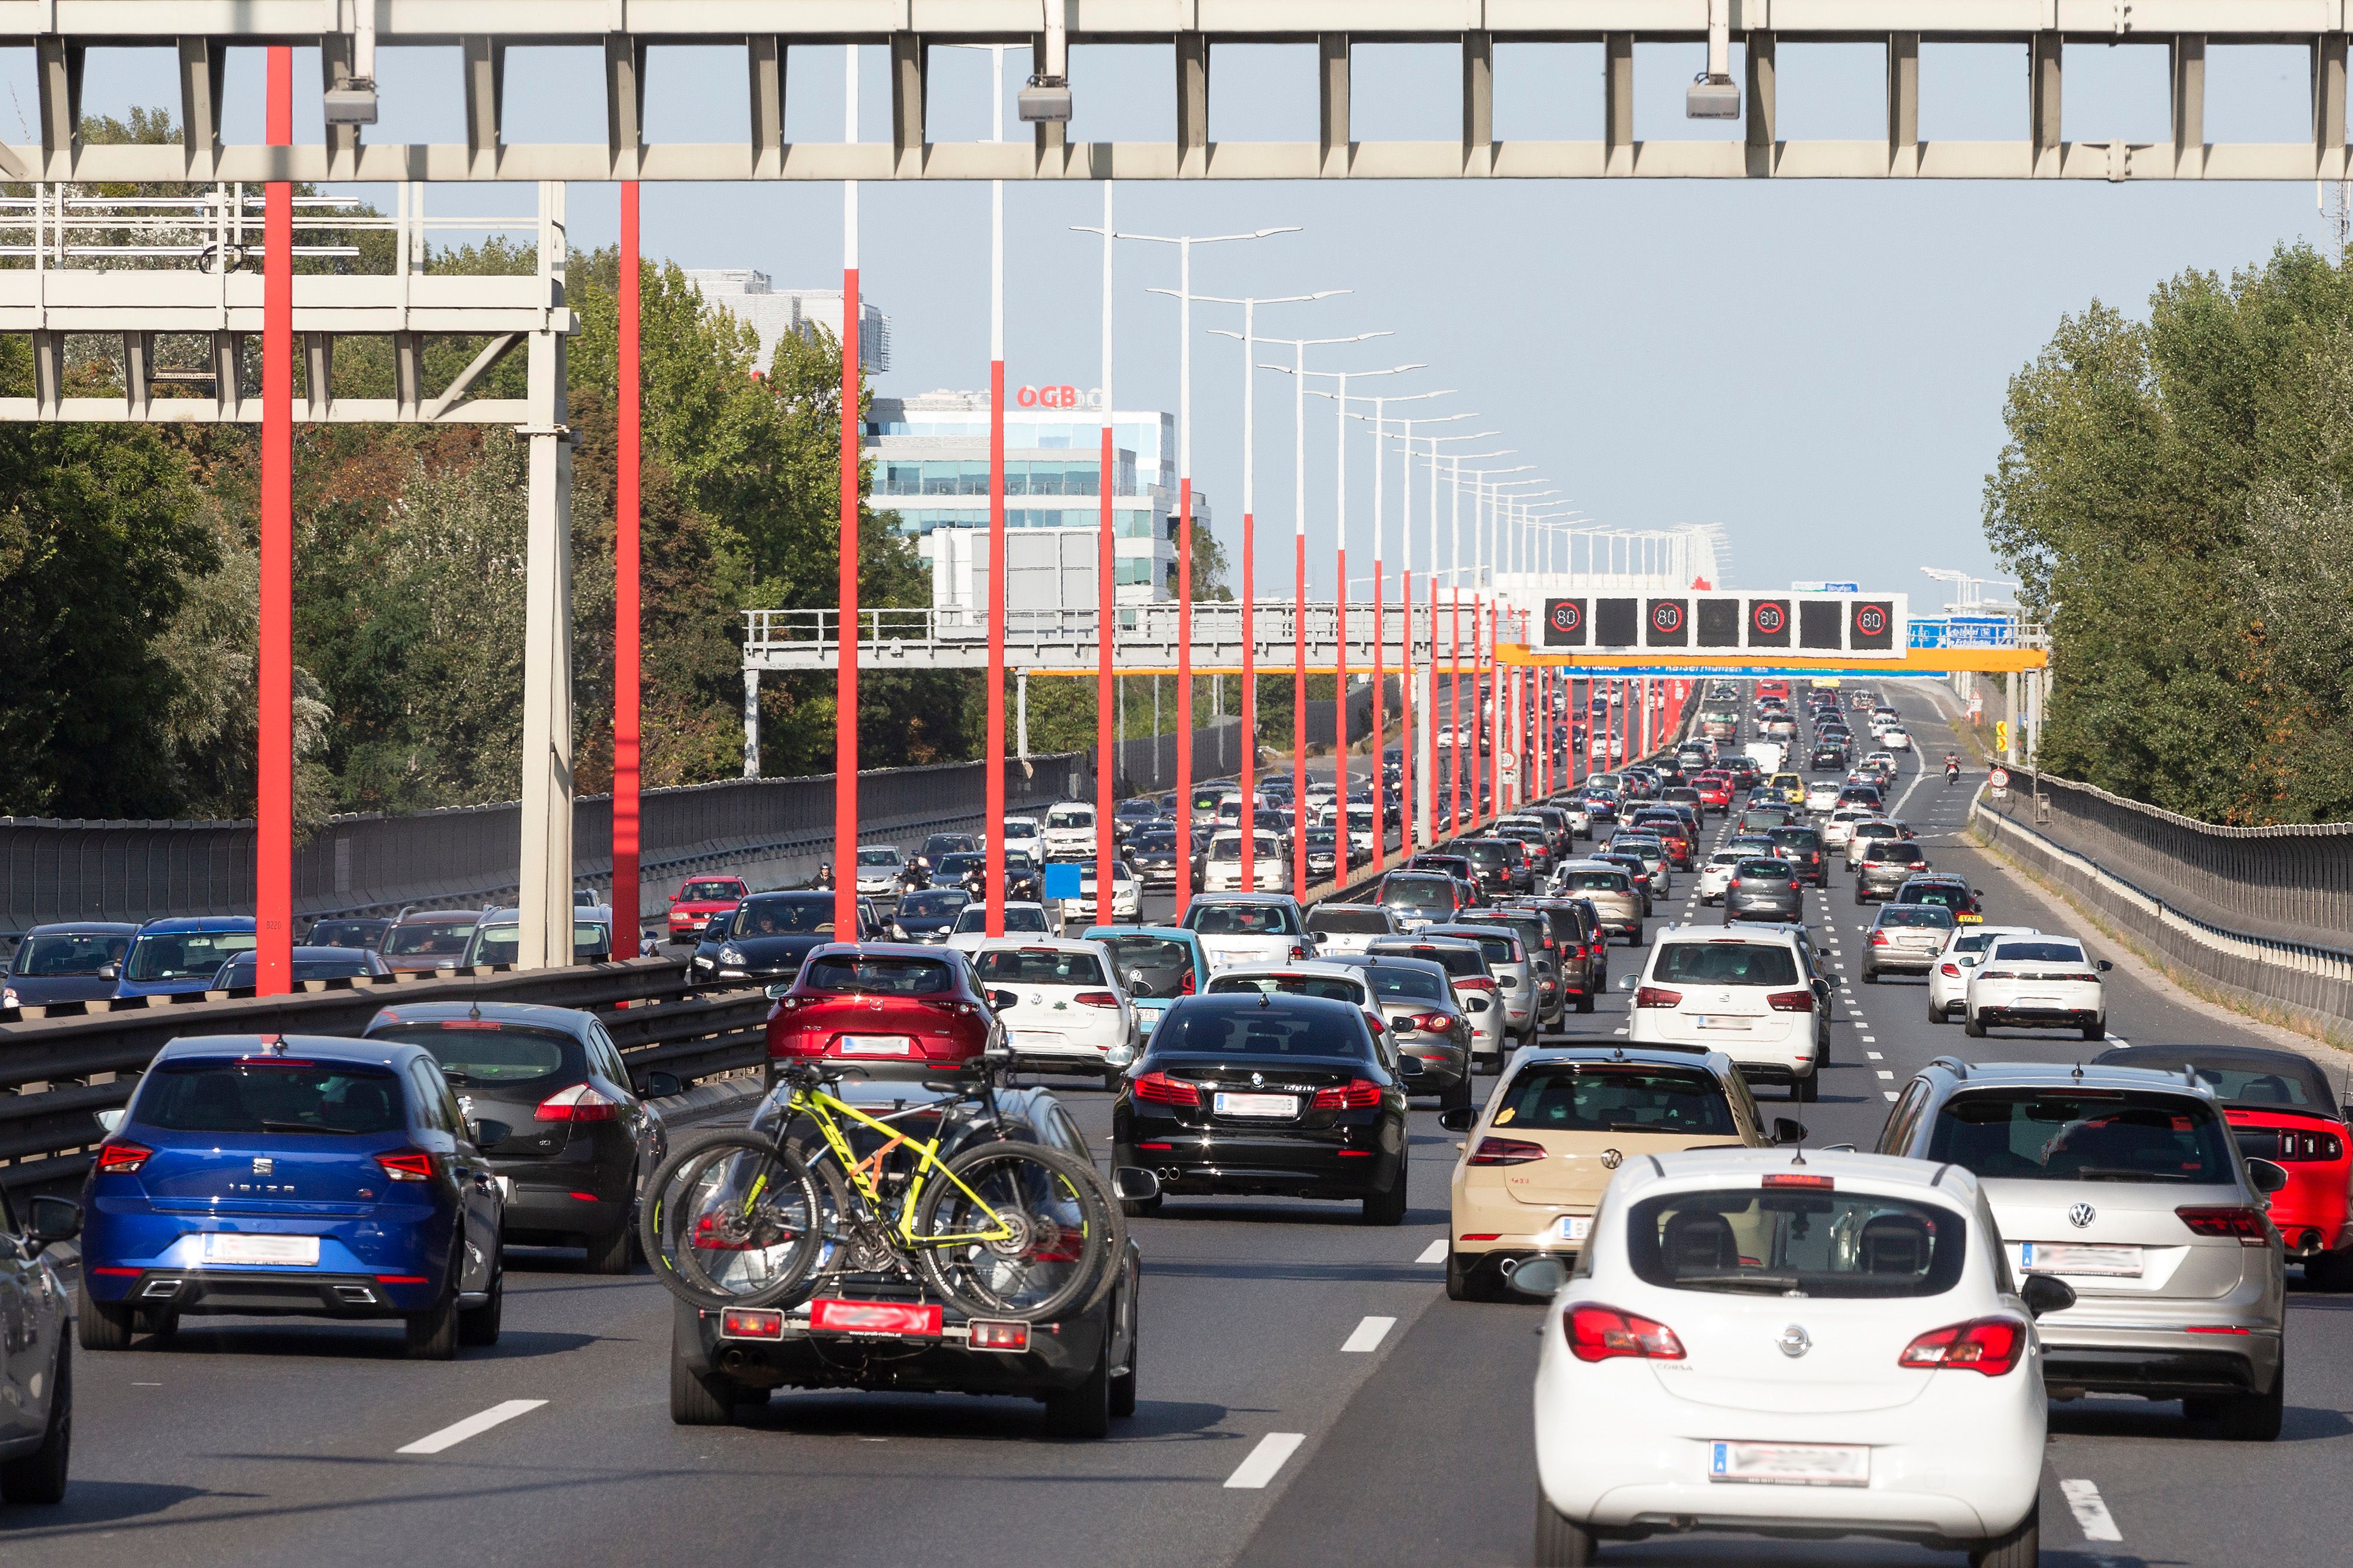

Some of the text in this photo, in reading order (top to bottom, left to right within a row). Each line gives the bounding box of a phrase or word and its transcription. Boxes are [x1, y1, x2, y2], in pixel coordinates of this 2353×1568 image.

[1557, 610, 1575, 625] 80
[1657, 610, 1677, 625] 80
[1759, 610, 1779, 626] 80
[1862, 613, 1881, 628] 80
[266, 921, 281, 930] B220
